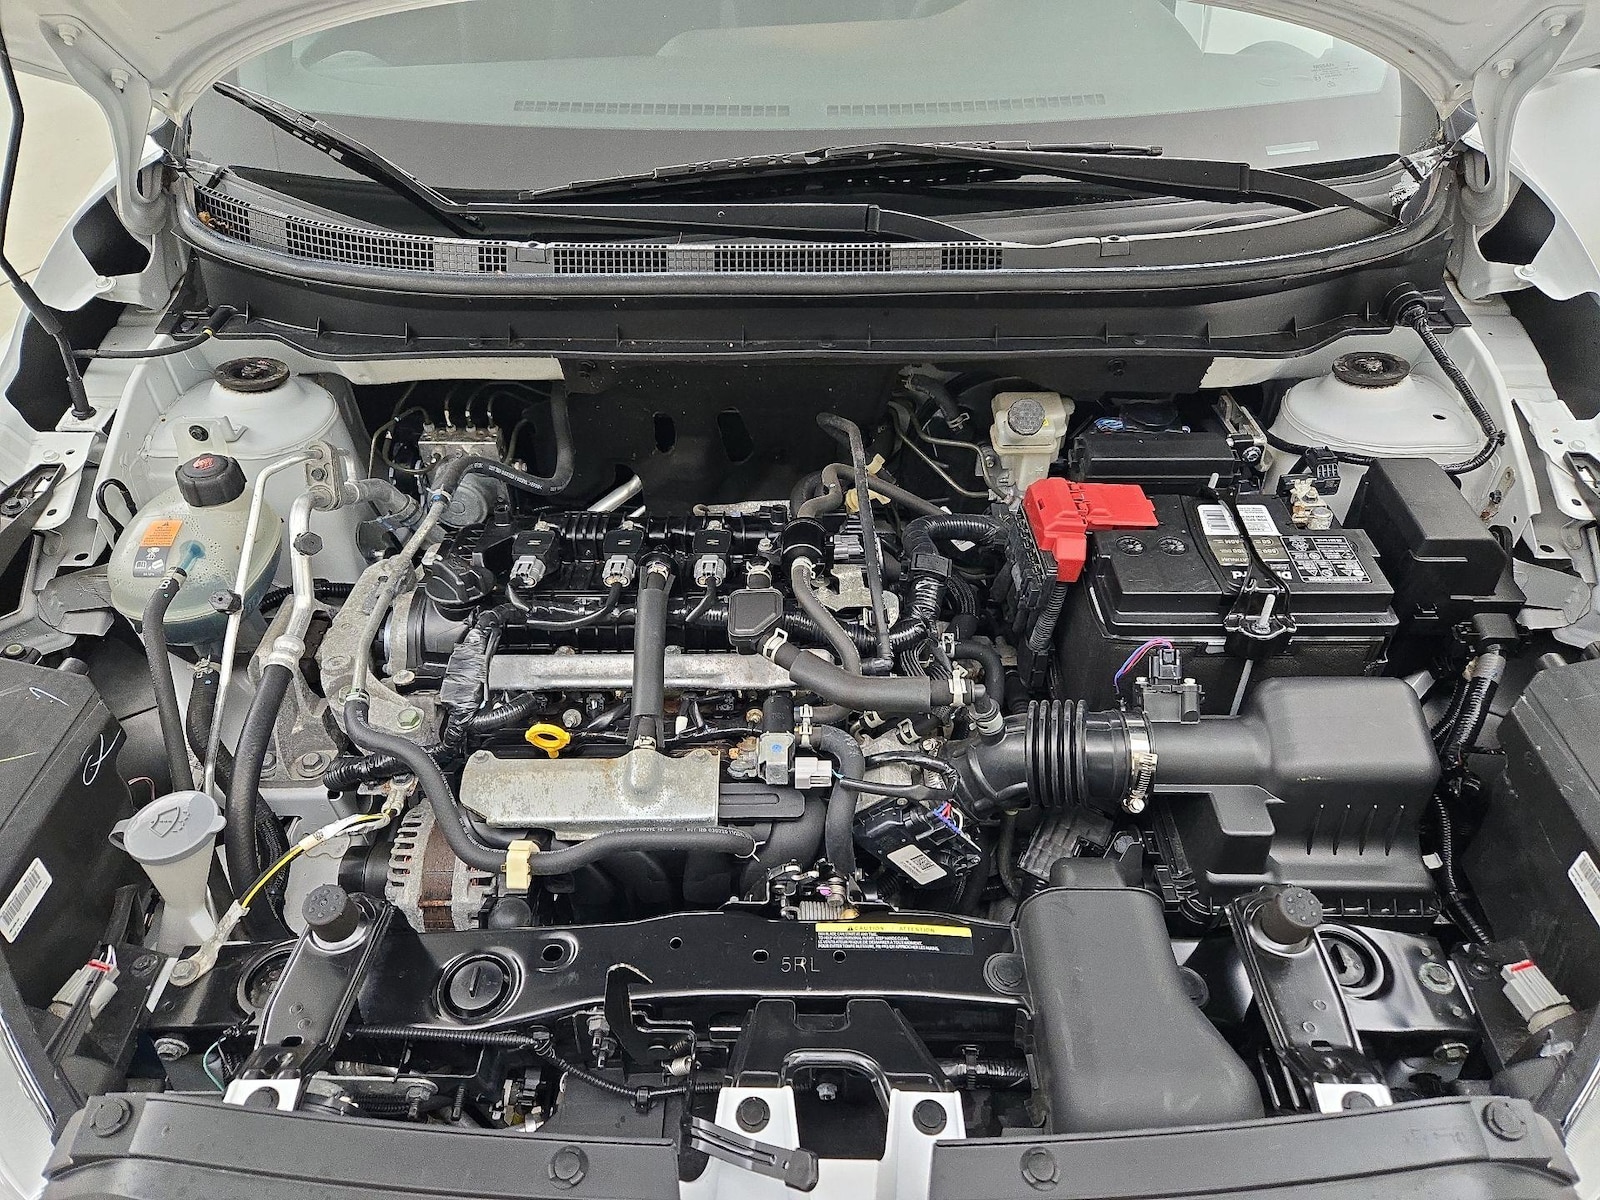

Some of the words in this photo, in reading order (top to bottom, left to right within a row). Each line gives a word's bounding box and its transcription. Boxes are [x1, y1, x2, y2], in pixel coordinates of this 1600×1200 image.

[1231, 570, 1293, 580] Dird
[159, 579, 171, 589] B
[780, 956, 821, 974] 5RL
